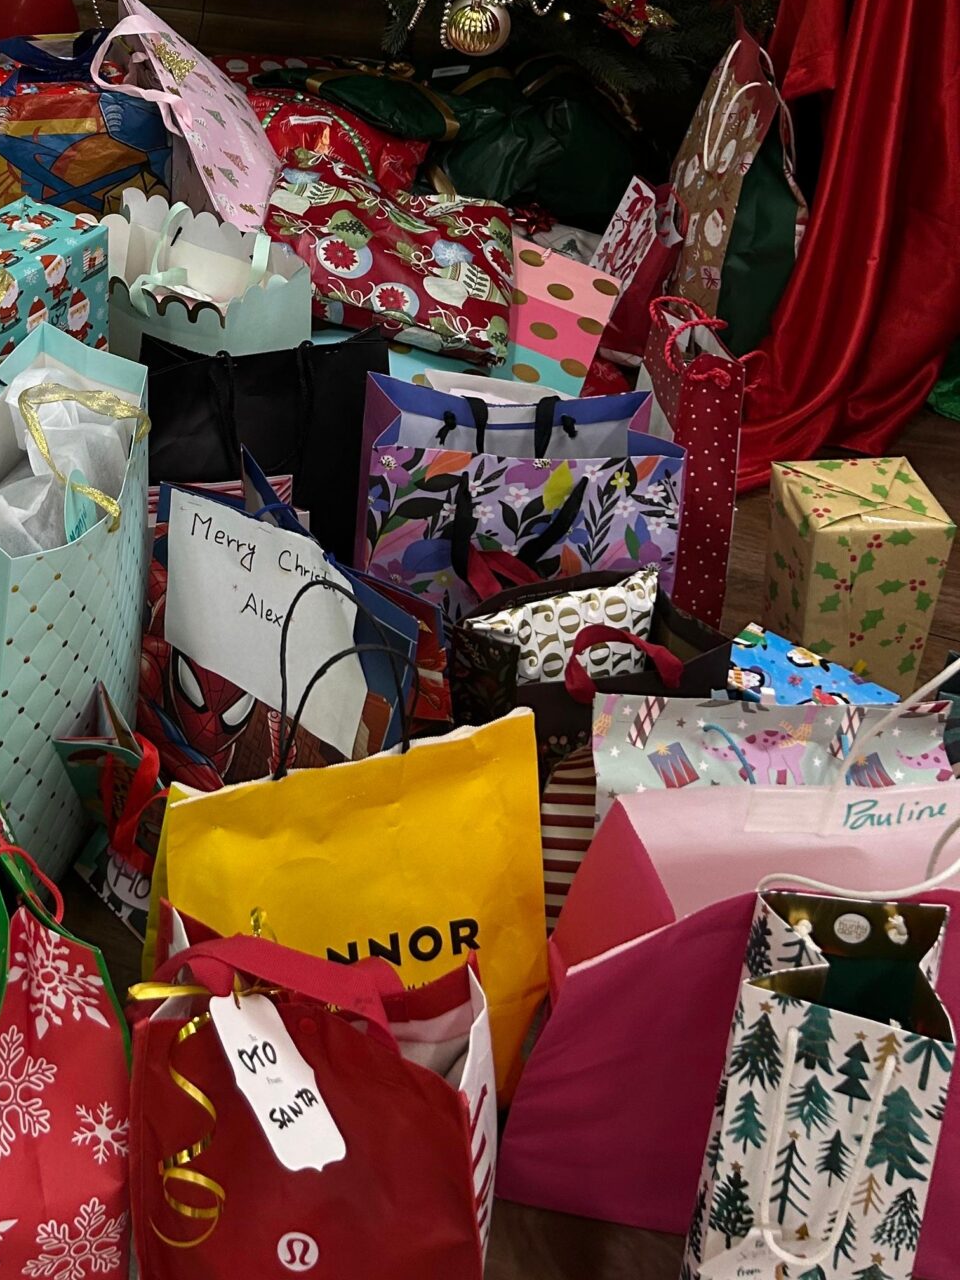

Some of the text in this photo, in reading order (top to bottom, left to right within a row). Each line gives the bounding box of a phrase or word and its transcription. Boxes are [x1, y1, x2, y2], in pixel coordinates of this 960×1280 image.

[191, 512, 256, 572] Merry
[241, 592, 284, 627] Alex
[843, 799, 947, 830] Pauline
[326, 918, 481, 967] NNOR
[269, 1087, 318, 1130] SANTA
